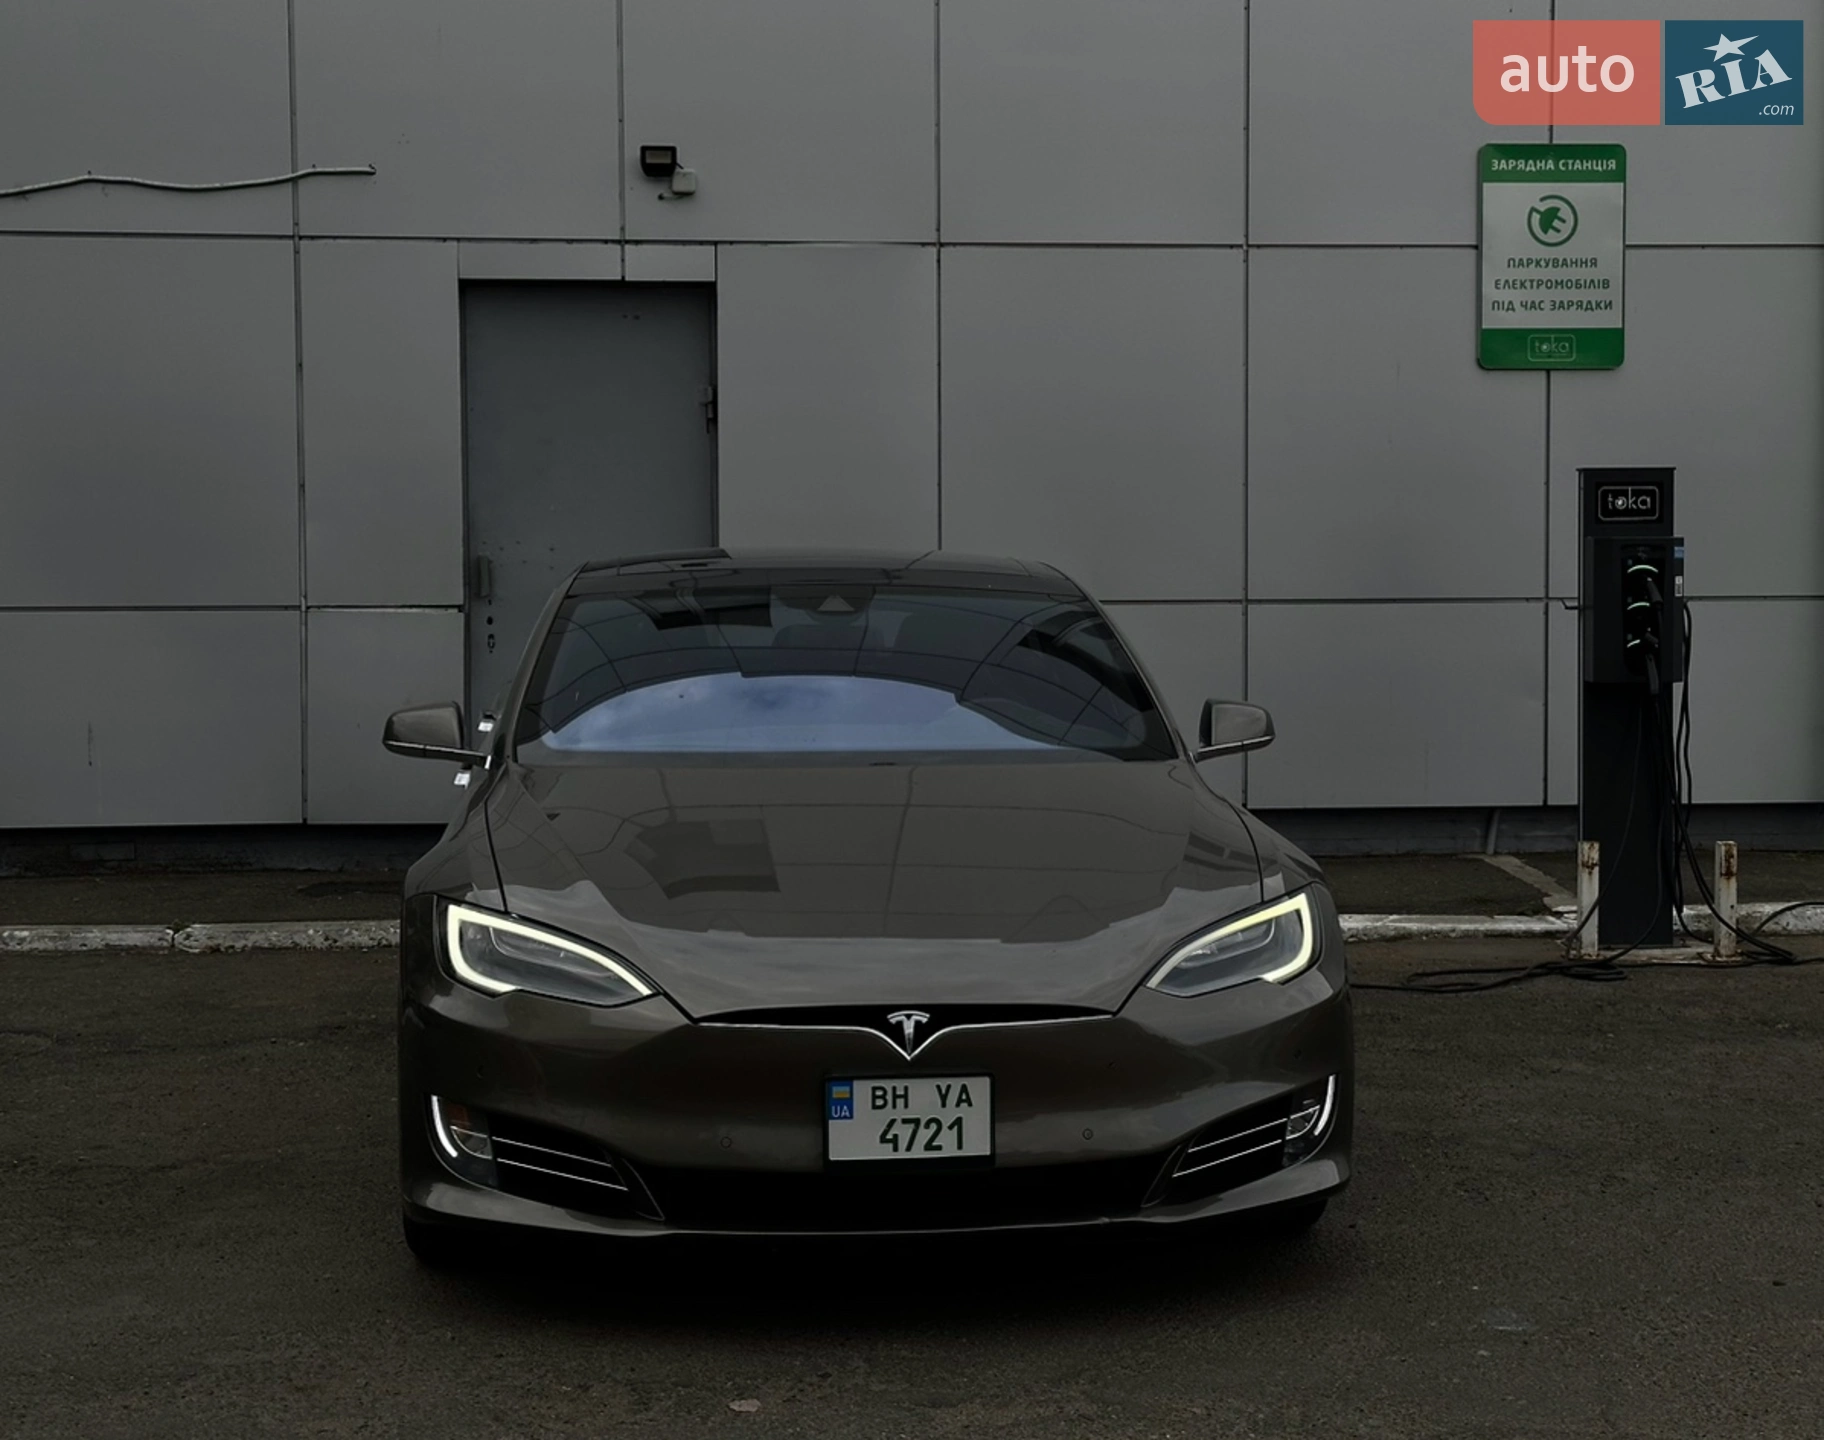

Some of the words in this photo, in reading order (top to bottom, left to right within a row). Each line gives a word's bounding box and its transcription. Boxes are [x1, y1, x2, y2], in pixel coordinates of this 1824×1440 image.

[1491, 159, 1555, 172] ЗАРЯДНА
[1558, 159, 1617, 172] СТАНЦІЯ
[1507, 257, 1598, 269] ПАРКУВАННЯ
[1494, 278, 1611, 290] ЕЛЕКТРОМОБІЛІВ
[1491, 300, 1516, 312] ПІД
[1520, 300, 1545, 311] ЧАС
[1549, 300, 1613, 312] ЗАРЯДКИ
[871, 1085, 909, 1110] BH
[936, 1083, 973, 1108] YA
[831, 1105, 851, 1118] UA
[879, 1116, 963, 1152] 4721
